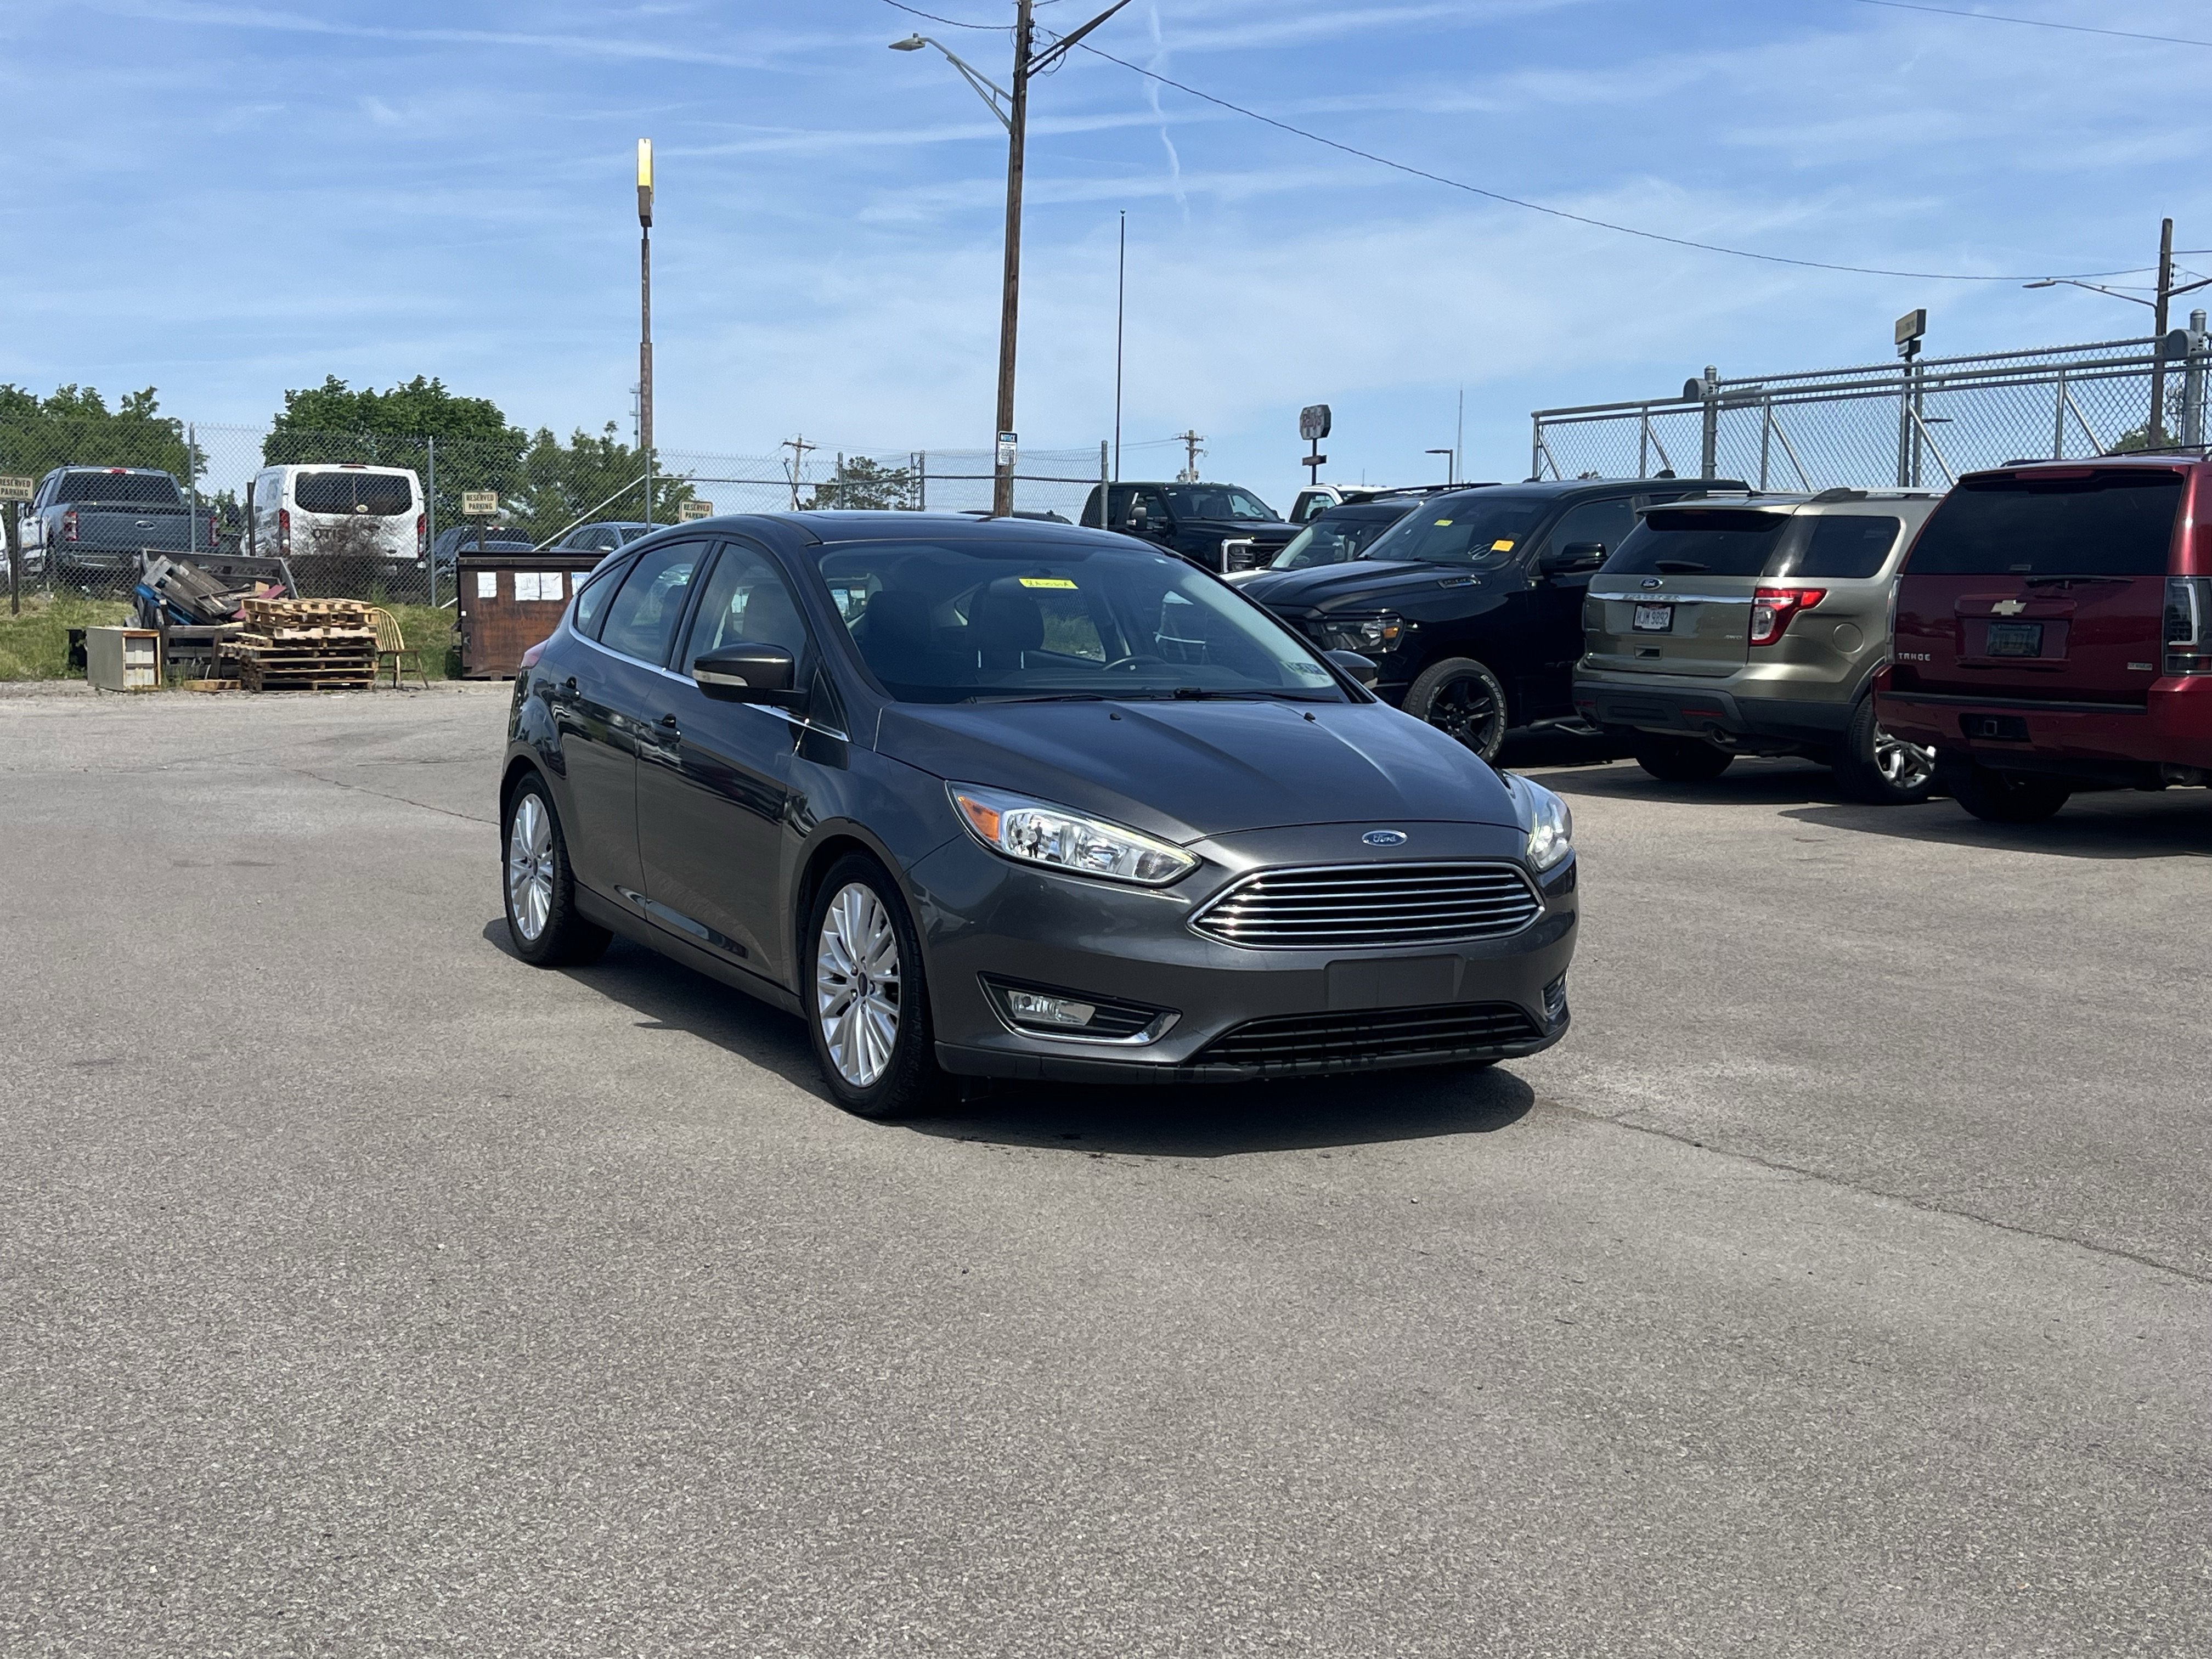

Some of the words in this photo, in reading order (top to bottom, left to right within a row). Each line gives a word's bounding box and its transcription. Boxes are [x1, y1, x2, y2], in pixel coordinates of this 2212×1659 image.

[1, 488, 28, 496] PARKING
[1898, 652, 1931, 662] TAHOE
[1373, 833, 1396, 843] Ford
